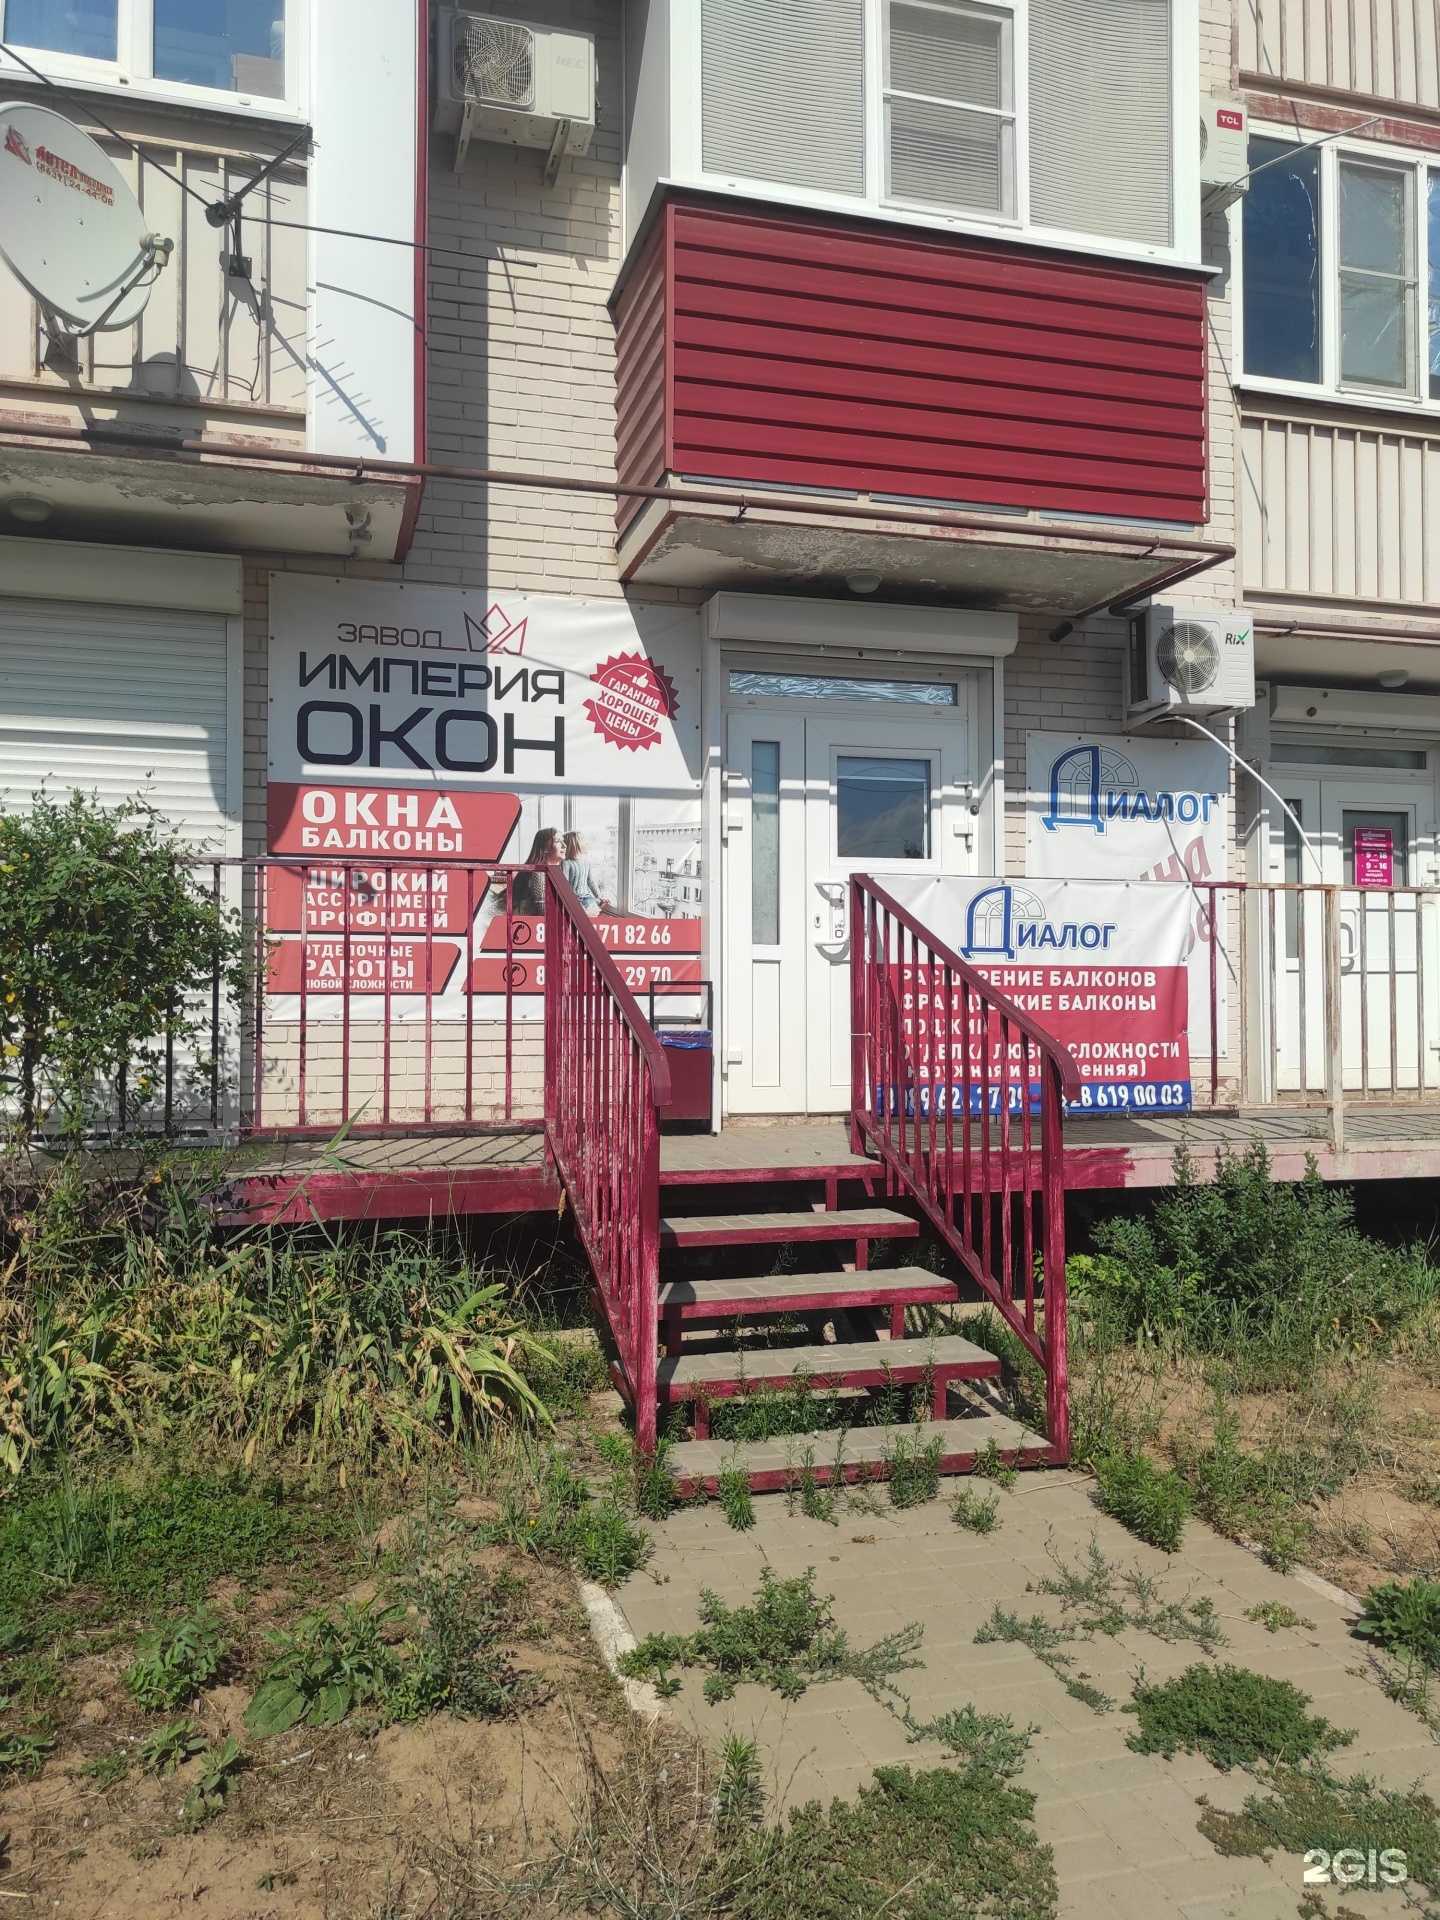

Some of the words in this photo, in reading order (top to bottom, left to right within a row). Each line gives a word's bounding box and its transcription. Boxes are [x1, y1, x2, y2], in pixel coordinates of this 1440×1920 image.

[1220, 114, 1239, 125] TCL
[337, 622, 443, 649] ЗАВОД
[299, 651, 565, 704] ИМПЕРИЯ
[607, 678, 660, 710] ГАРАНТИЯ
[598, 690, 660, 728] ХОРОШЕЙ
[606, 711, 641, 737] ЦЕНЫ
[297, 700, 565, 777] ОКОН
[1042, 745, 1217, 833] ДИАЛОГ
[302, 790, 463, 829] ОКНА
[302, 827, 463, 853] БАЛКОНЫ
[593, 924, 619, 944] 71
[625, 925, 646, 945] 82
[650, 925, 671, 945] 66
[960, 885, 1117, 960] ДИАЛОГ
[349, 979, 413, 989] ЛОЖНСТИ
[625, 966, 646, 986] 29
[903, 969, 1043, 987] РАШРЕНИЕ
[1050, 969, 1156, 987] БАЛКОНОВ
[903, 993, 1052, 1012] ФРАНКИЕ
[1058, 994, 1156, 1011] БАЛКОНЫ
[1067, 1041, 1180, 1059] СЛОЖНОСТИ
[1097, 1085, 1129, 1107] 619
[1133, 1085, 1157, 1106] 00
[1161, 1084, 1183, 1106] 03
